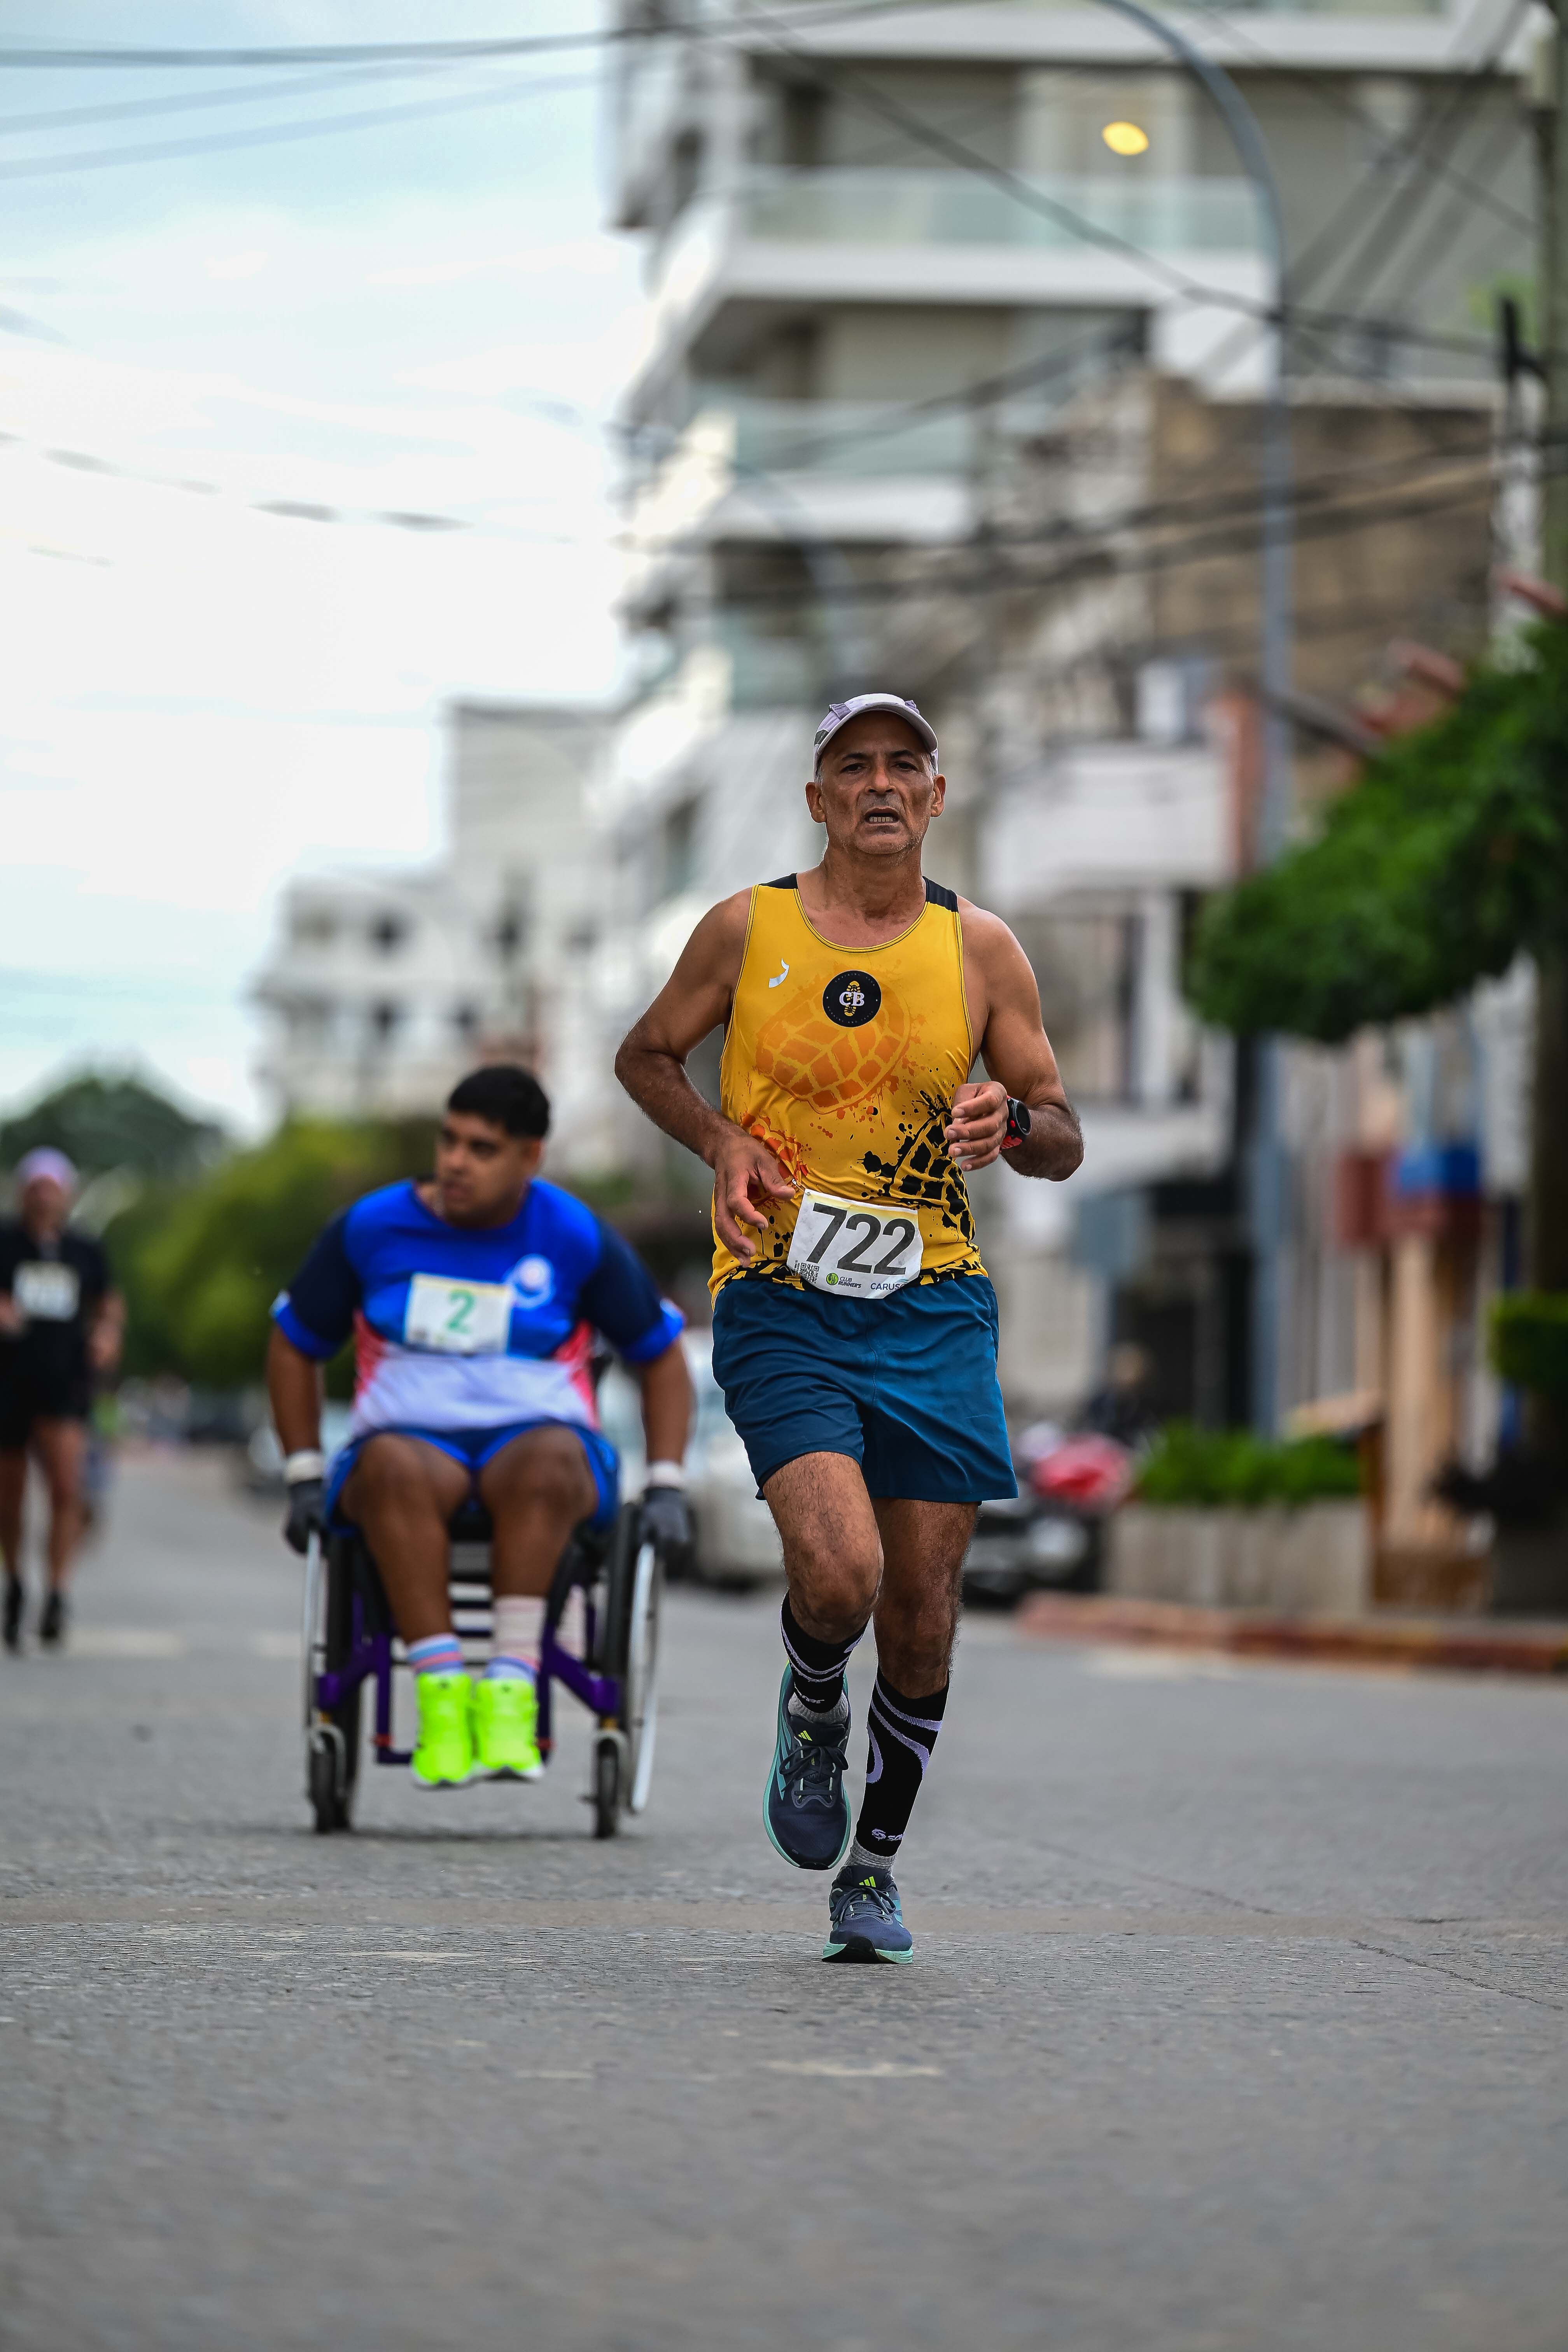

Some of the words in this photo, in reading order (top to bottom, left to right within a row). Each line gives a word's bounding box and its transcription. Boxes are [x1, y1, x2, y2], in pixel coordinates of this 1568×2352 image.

[839, 991, 864, 1006] CB
[806, 1202, 915, 1275] 722
[446, 1288, 476, 1334] 2
